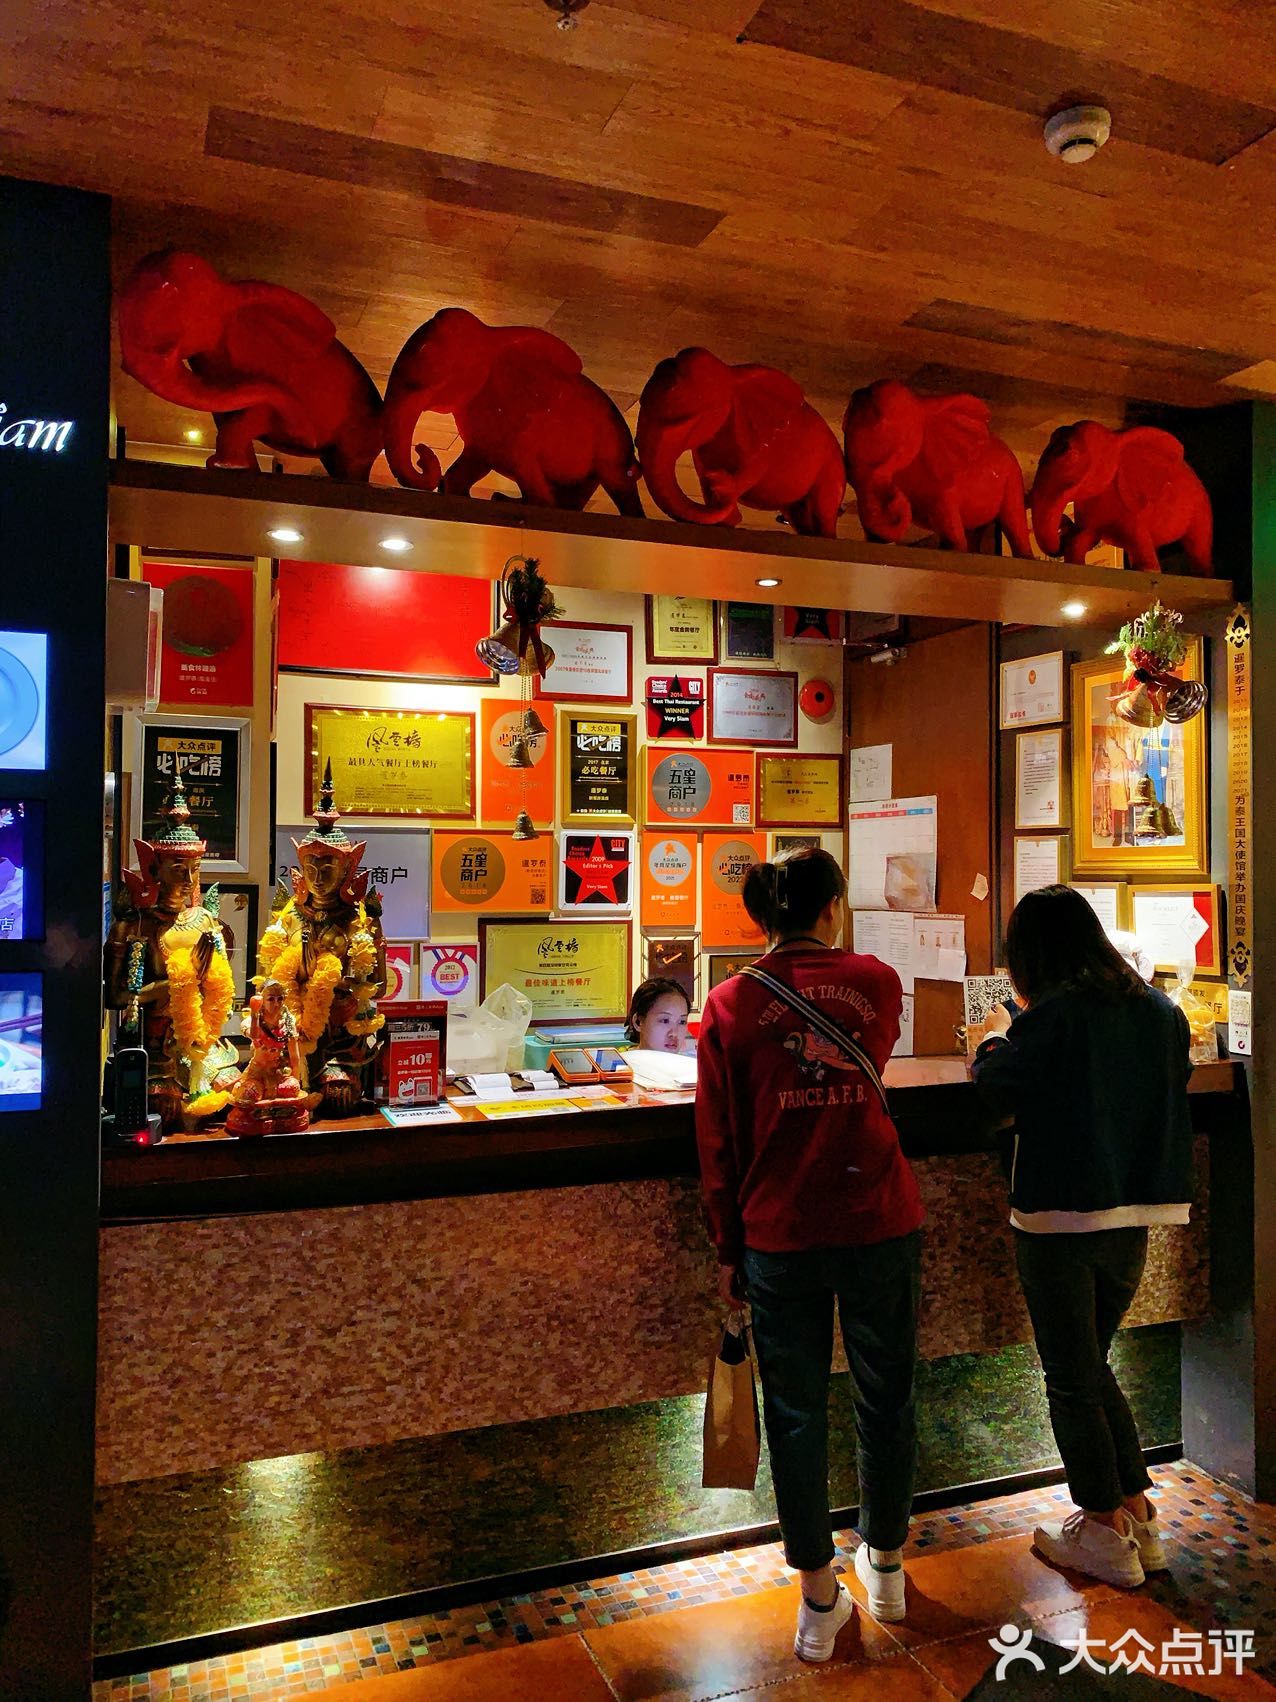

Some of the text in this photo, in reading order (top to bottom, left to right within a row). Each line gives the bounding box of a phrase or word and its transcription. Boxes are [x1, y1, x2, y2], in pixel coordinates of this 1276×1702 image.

[591, 724, 617, 733] 大众点评
[177, 740, 216, 752] 大众点评
[581, 766, 617, 776] 必吃餐厅
[669, 768, 696, 785] 五星
[669, 785, 697, 800] 商户
[460, 853, 487, 868] 五星
[461, 868, 488, 882] 商户
[440, 973, 461, 981] BEST
[410, 1053, 426, 1066] 10
[778, 1088, 824, 1110] VANCE
